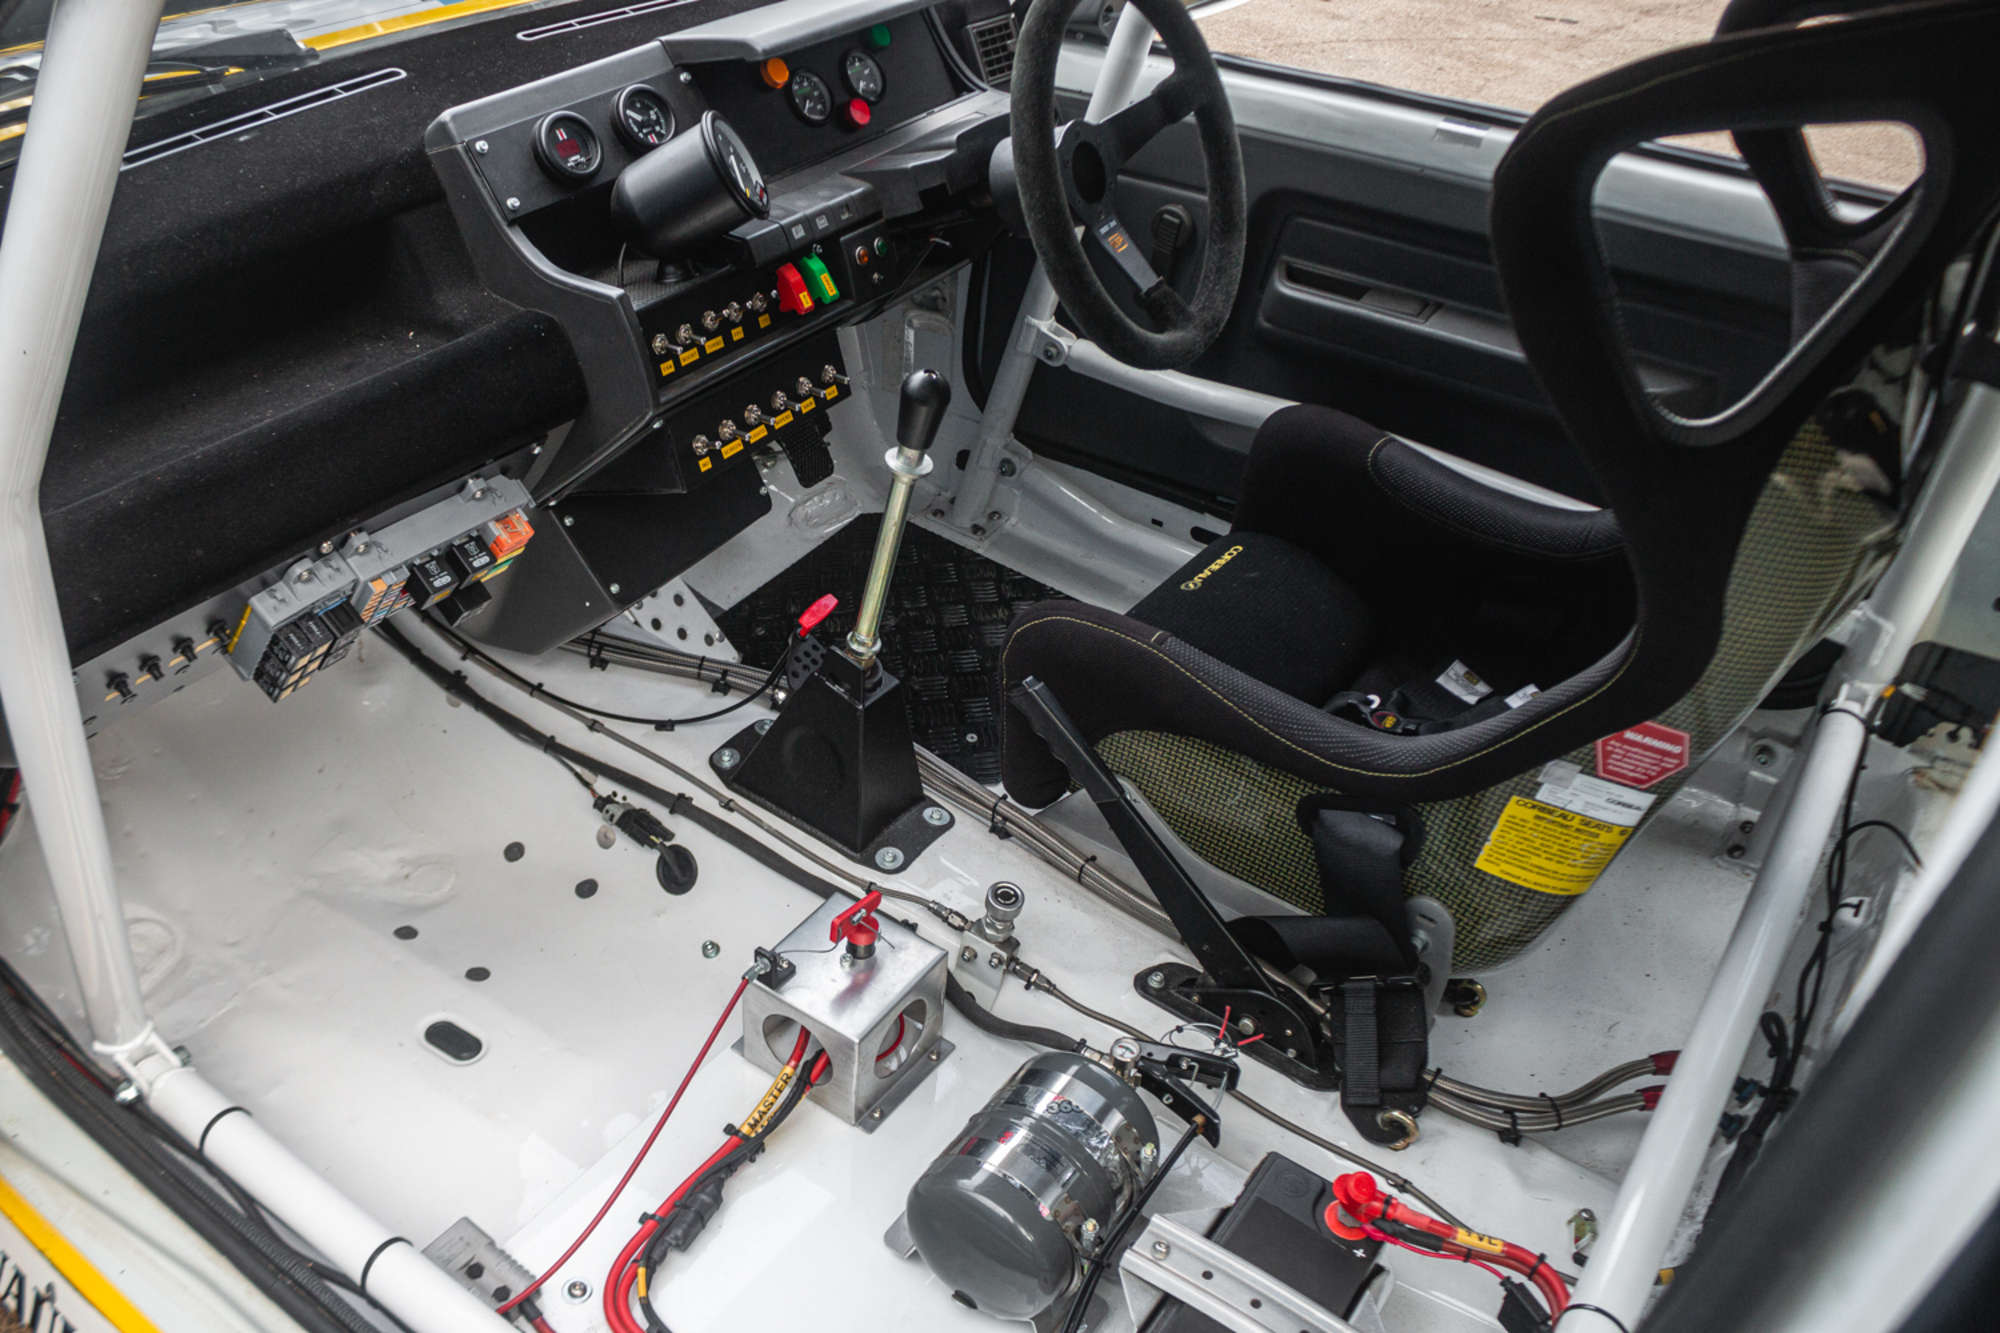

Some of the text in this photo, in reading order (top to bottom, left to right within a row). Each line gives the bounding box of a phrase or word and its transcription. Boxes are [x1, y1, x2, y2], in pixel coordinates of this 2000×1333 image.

[1624, 731, 1682, 753] WARNING
[1516, 799, 1613, 834] CORBEAU SEATS
[747, 1072, 792, 1131] MASTER
